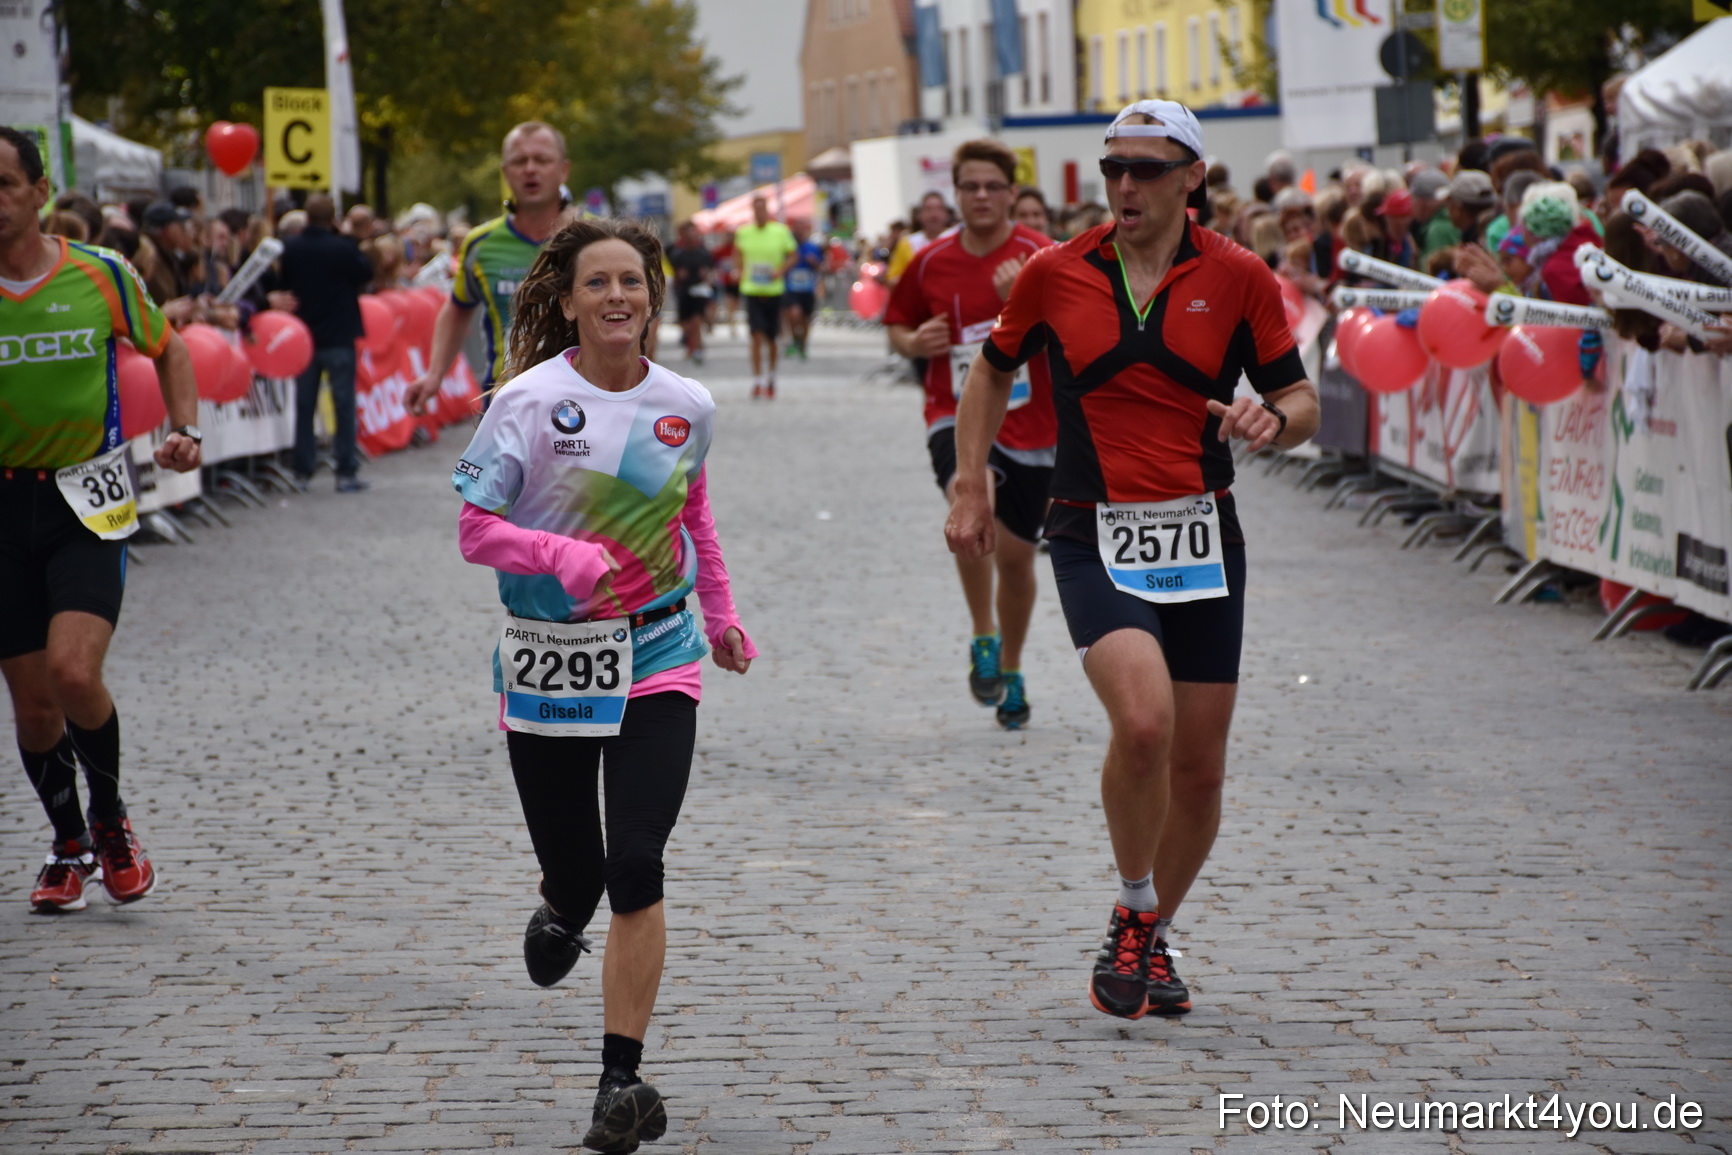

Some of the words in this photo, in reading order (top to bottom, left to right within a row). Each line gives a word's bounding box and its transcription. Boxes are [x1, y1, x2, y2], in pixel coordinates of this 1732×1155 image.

[273, 94, 322, 112] Block
[281, 119, 313, 166] C
[1651, 215, 1691, 250] BMW
[660, 422, 685, 439] Hervis
[553, 439, 590, 450] PARTL
[555, 449, 590, 457] Neumarkt
[1143, 506, 1197, 520] Neumarkt
[1112, 521, 1210, 564] 2570
[1145, 574, 1184, 589] Sven
[505, 628, 545, 643] PARTL
[547, 633, 608, 646] Neumarkt
[637, 614, 685, 646] Stadtlauf
[513, 648, 620, 692] 2293
[539, 702, 593, 719] Gisela
